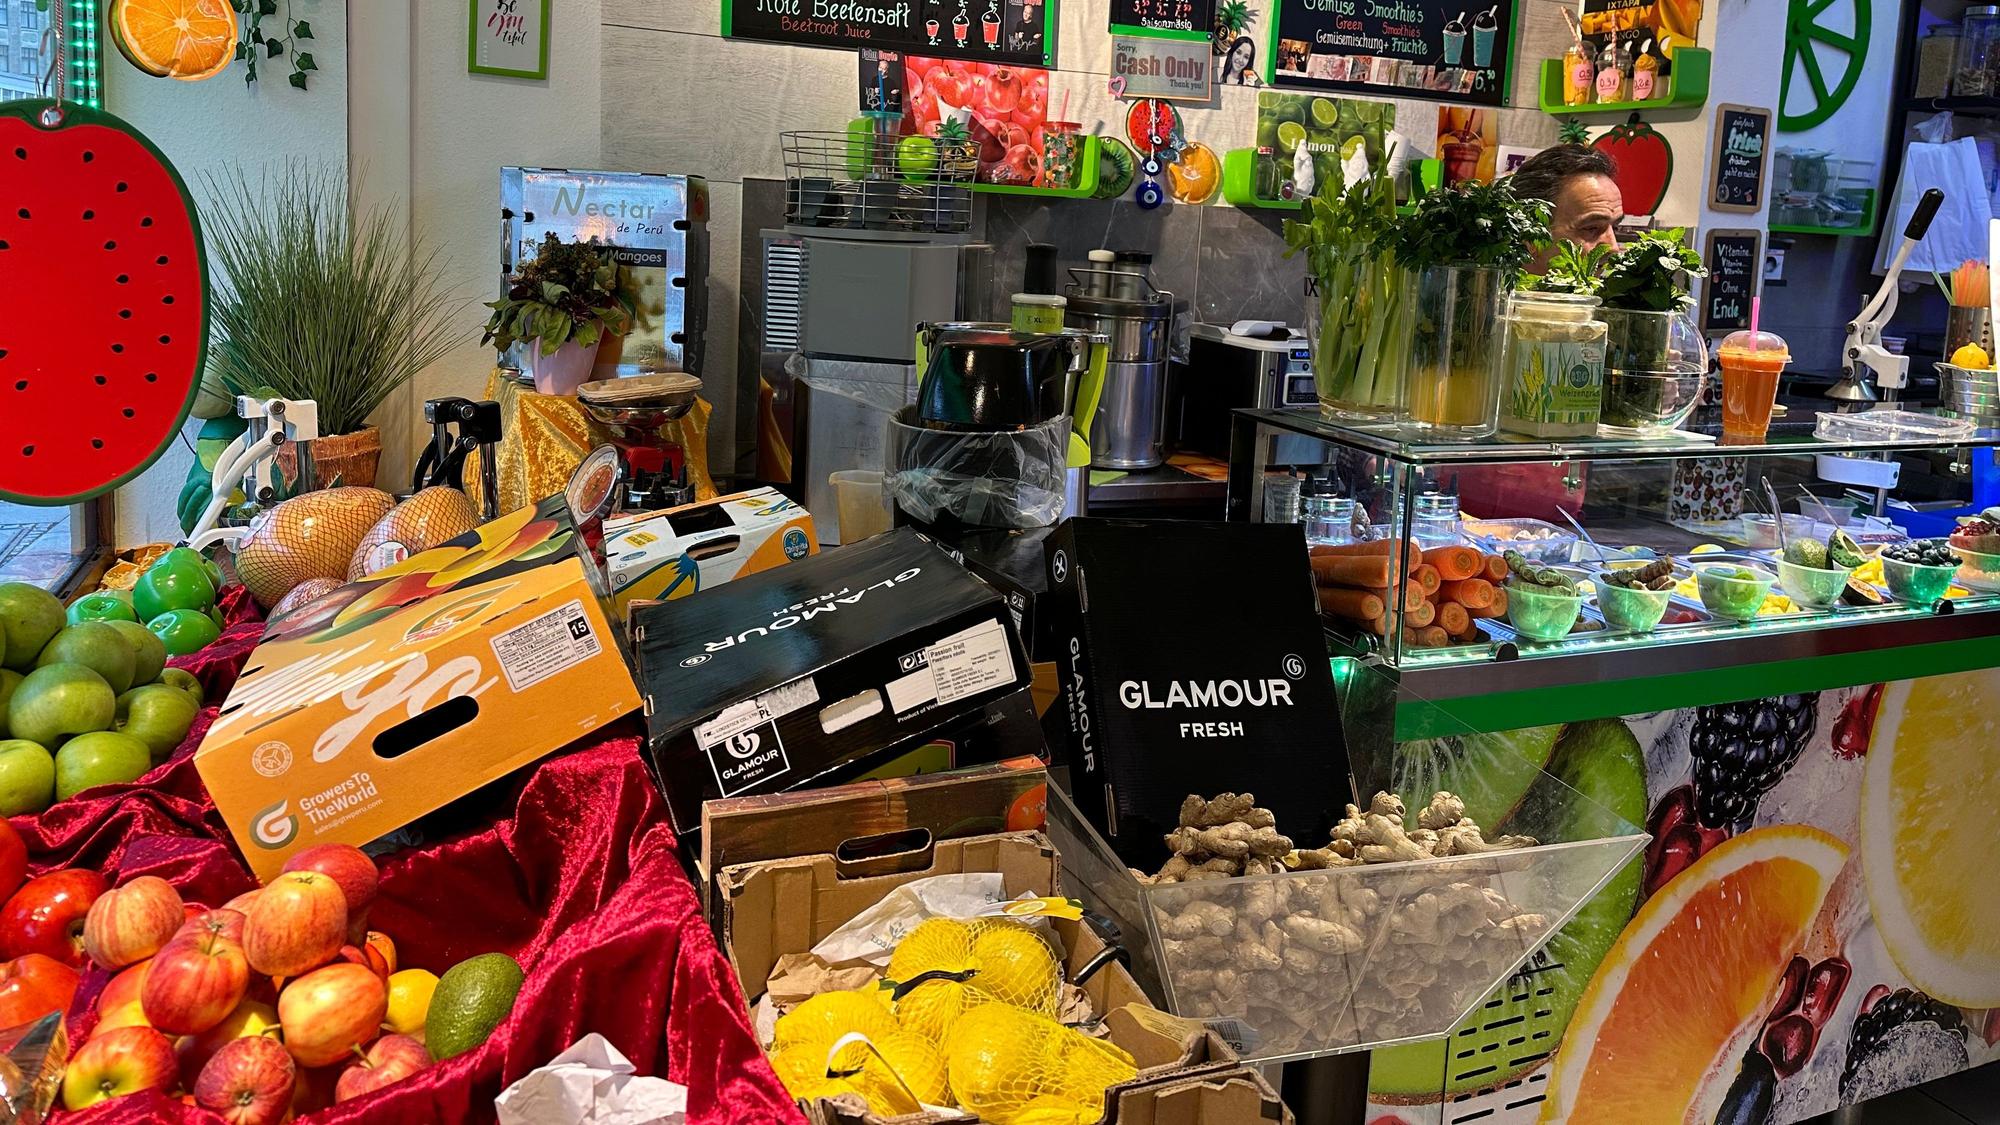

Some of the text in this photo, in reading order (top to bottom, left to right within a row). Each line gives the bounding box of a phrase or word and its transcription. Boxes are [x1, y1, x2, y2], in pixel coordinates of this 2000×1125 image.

[1303, 0, 1356, 16] Gemüse
[1607, 0, 1640, 9] IXTAPA
[812, 0, 911, 28] Beetensaft
[781, 16, 872, 39] Beetroot Juice
[1336, 14, 1363, 31] Green
[1315, 29, 1383, 54] Gemüsemischung
[1391, 37, 1428, 56] Früchte
[1603, 29, 1640, 42] MNGO
[1117, 43, 1138, 53] Sorry,
[1116, 52, 1204, 80] Cash Only
[1170, 79, 1204, 90] Thank you!
[1291, 137, 1335, 153] Lmon
[553, 183, 655, 219] Nectar
[616, 222, 663, 235] de Perú
[609, 249, 662, 264] Mangoes
[1721, 281, 1739, 293] Ohne
[1713, 297, 1740, 319] Ende
[704, 567, 920, 652] GLAMOUR
[773, 587, 850, 618] FRESH
[571, 621, 587, 635] 15
[930, 642, 965, 657] Passion fruit
[1119, 678, 1294, 709] GLAMOUR
[1066, 683, 1078, 733] FRESH
[1070, 637, 1095, 773] GLAMOUR
[897, 710, 919, 723] Product
[1179, 722, 1244, 738] FRESH
[722, 749, 779, 779] GLAMOUR
[743, 767, 764, 780] FRESH
